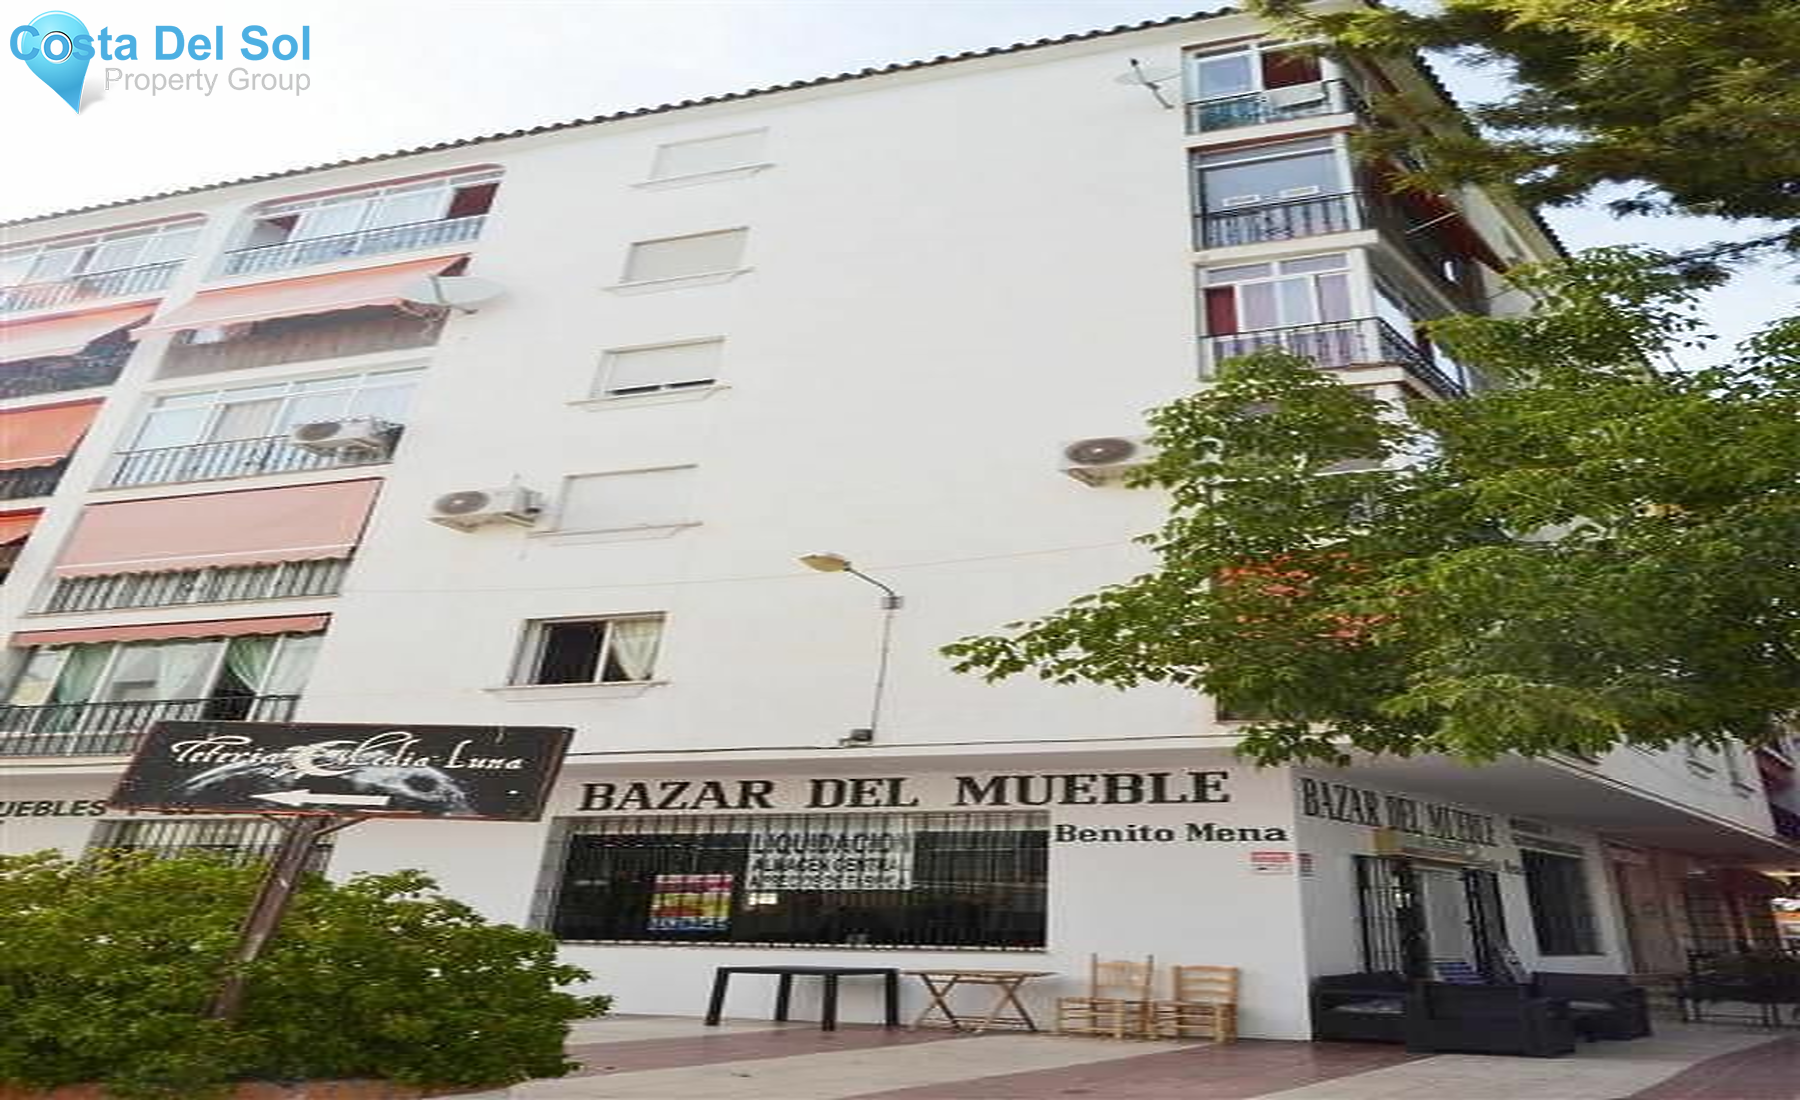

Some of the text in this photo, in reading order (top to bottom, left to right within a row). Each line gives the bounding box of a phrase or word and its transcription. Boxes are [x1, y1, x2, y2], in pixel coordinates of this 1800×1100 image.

[577, 771, 1231, 811] BAZAR DEL MUEBLE
[1301, 777, 1380, 827] BAZAR
[1055, 823, 1289, 843] Benito Mena
